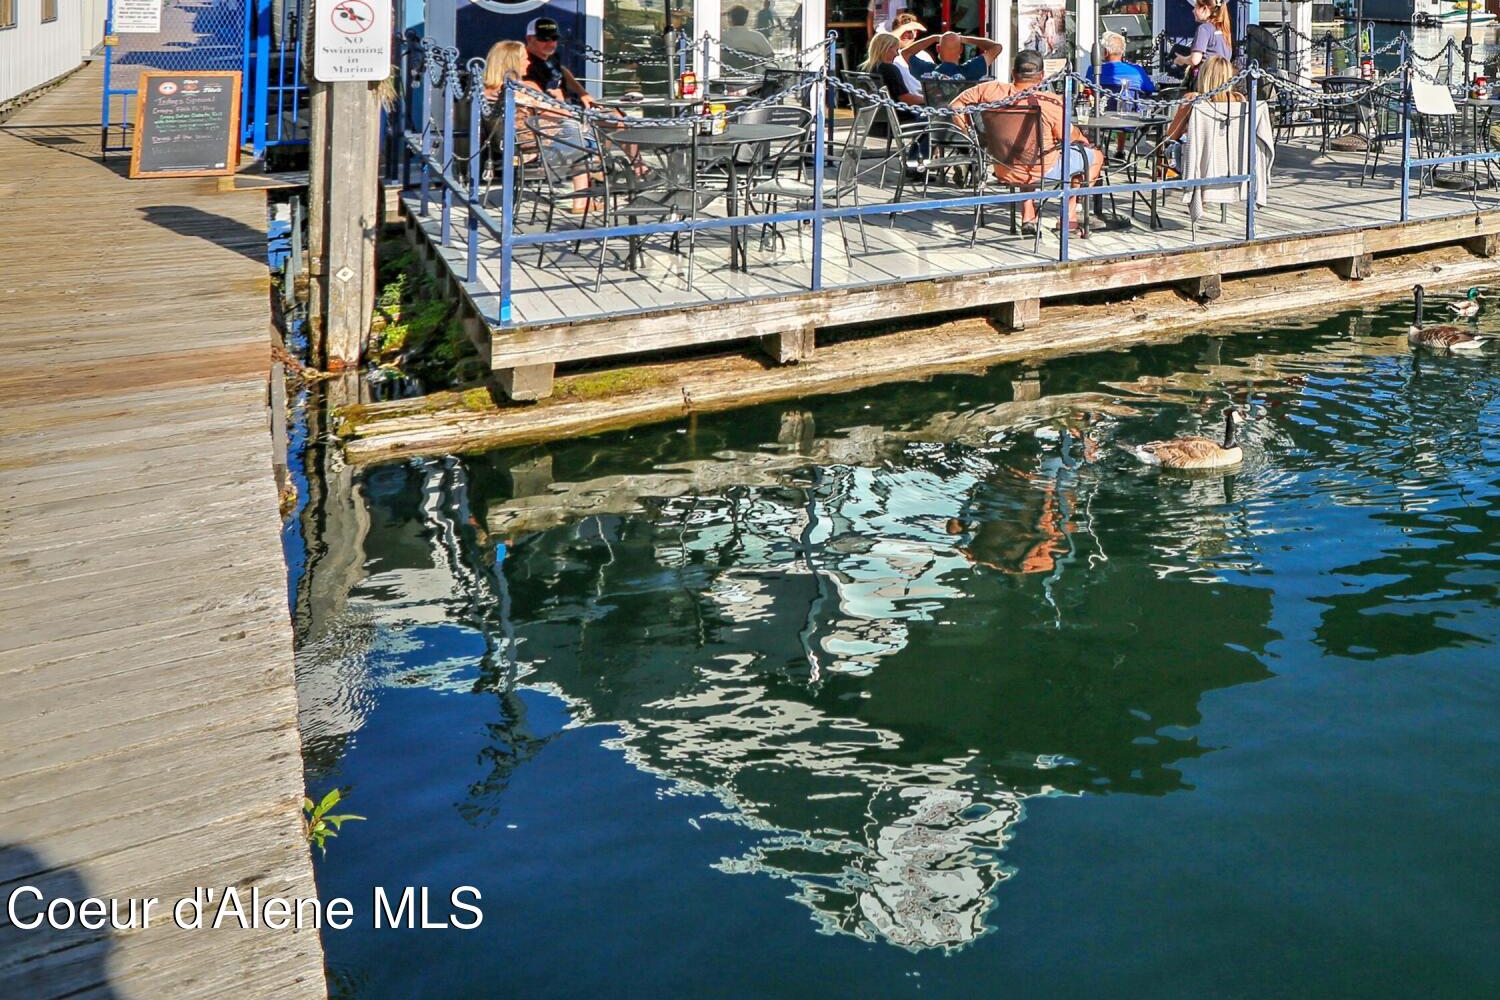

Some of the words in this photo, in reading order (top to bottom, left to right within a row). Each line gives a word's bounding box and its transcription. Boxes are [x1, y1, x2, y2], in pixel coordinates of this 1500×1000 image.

[345, 36, 364, 44] NO
[322, 46, 384, 55] Swimming
[347, 56, 359, 64] in
[332, 65, 374, 73] Marina
